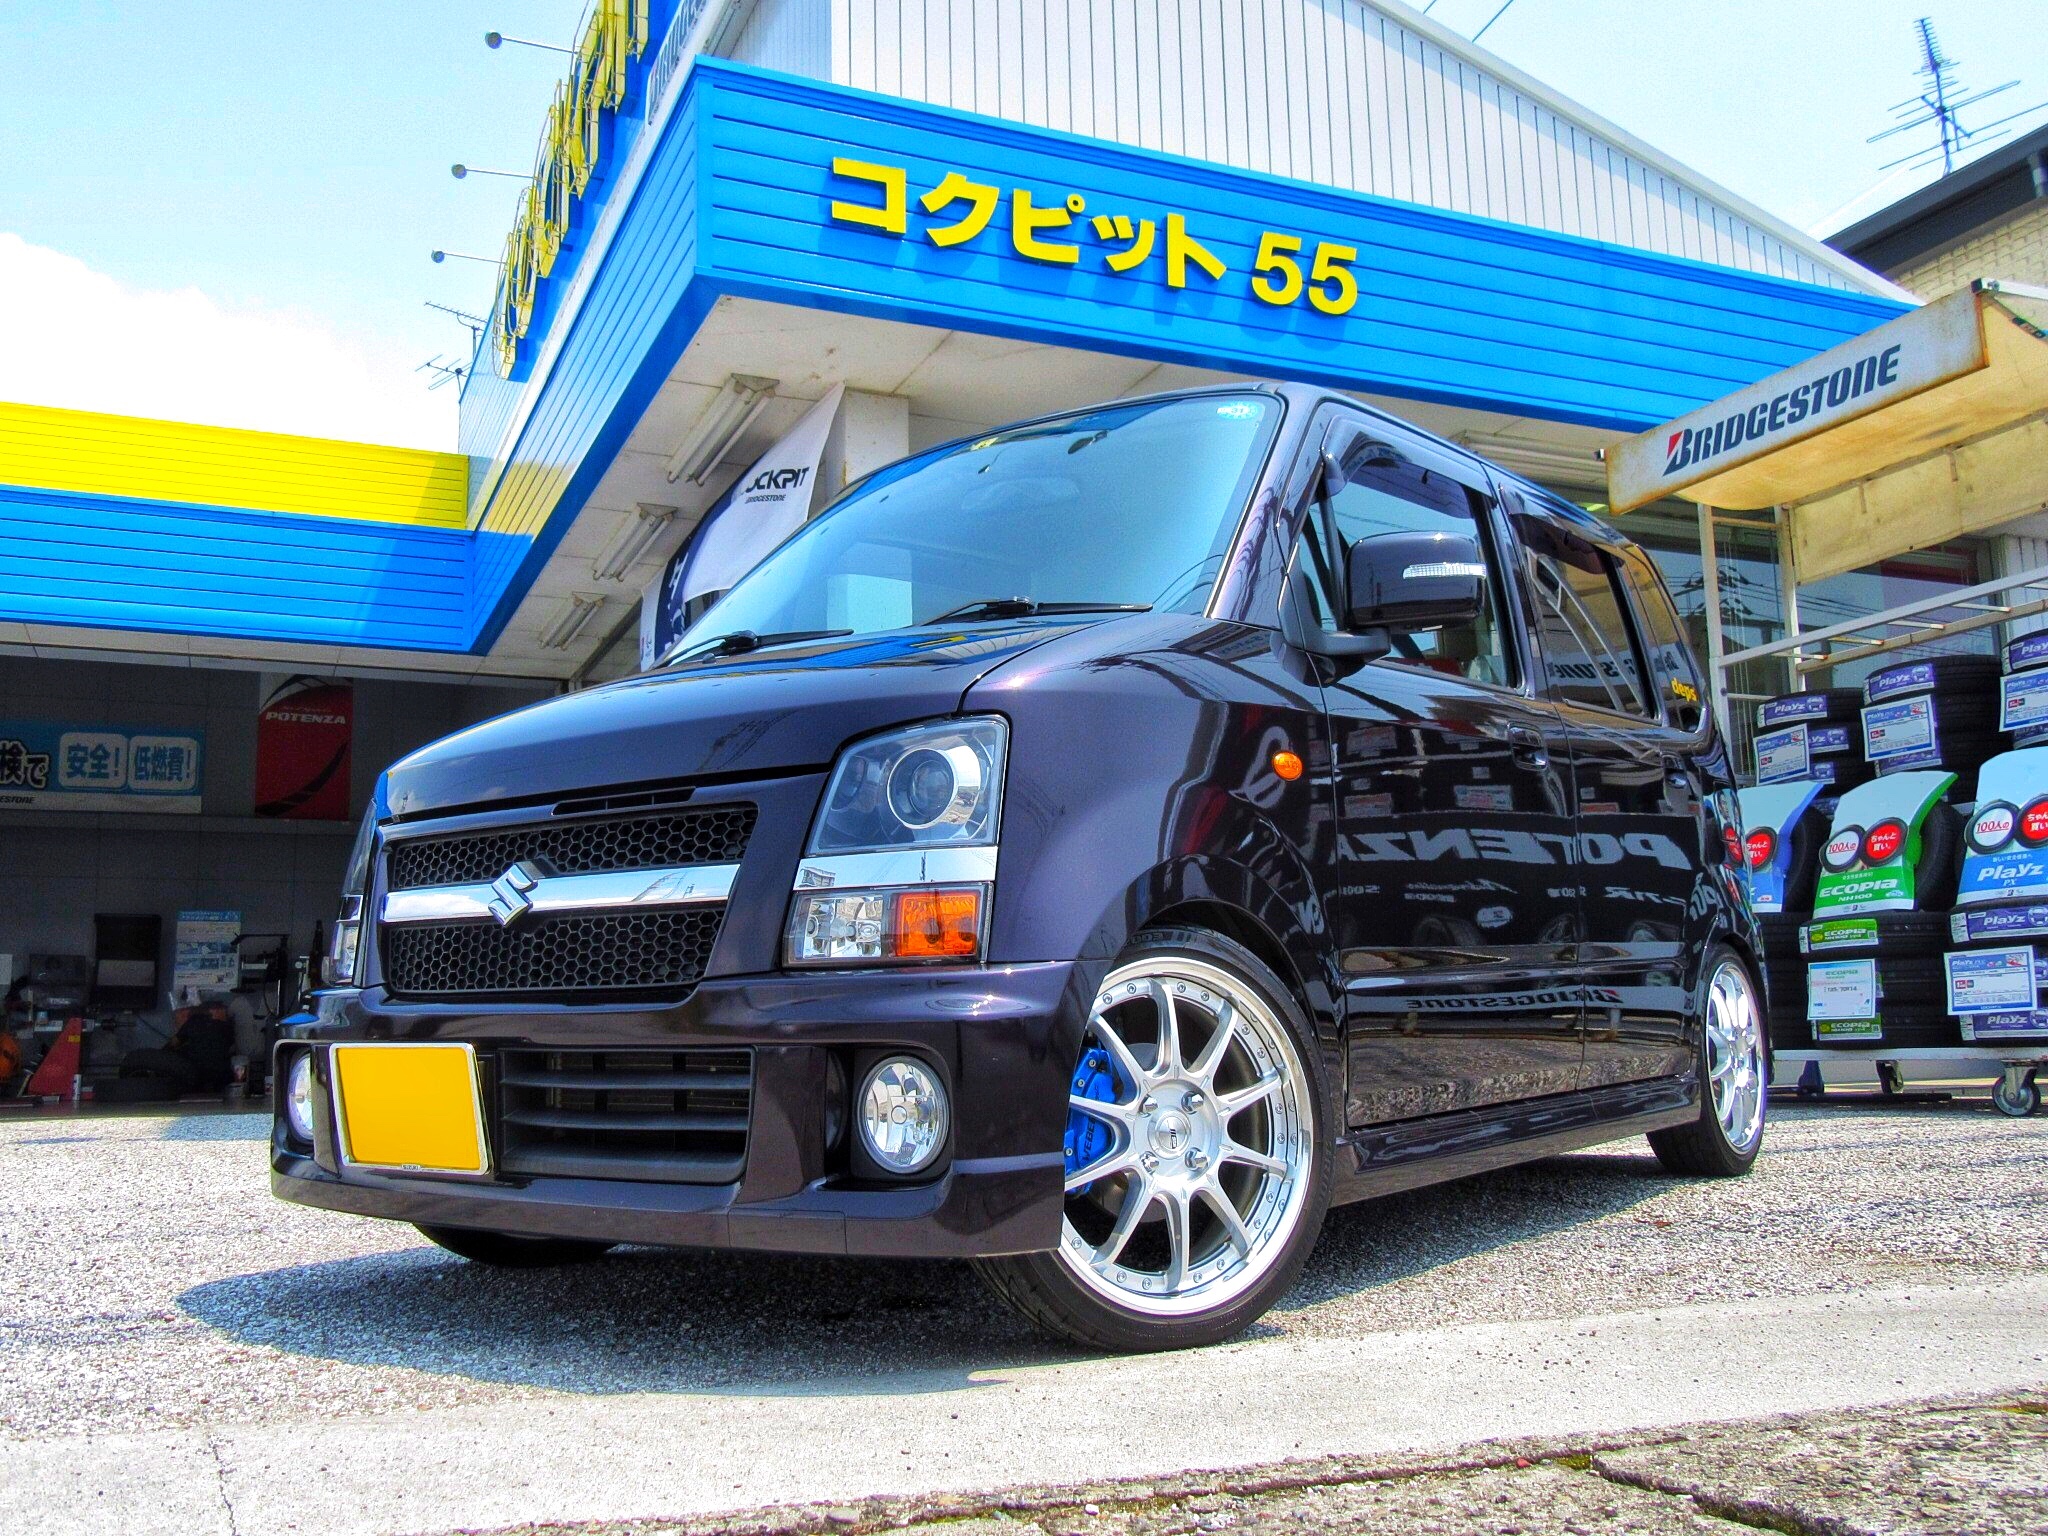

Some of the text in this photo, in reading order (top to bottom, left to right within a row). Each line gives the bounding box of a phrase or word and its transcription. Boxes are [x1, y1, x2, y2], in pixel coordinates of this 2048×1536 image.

[832, 157, 1358, 316] コクピット 55
[1662, 343, 1902, 477] BRIDGESTONE
[1671, 677, 1698, 702] deps
[265, 711, 346, 725] POTENZA
[66, 743, 121, 781] 安全!
[1976, 863, 2045, 882] Playz
[1983, 914, 2026, 926] Playz
[1986, 1014, 2028, 1025] Playz
